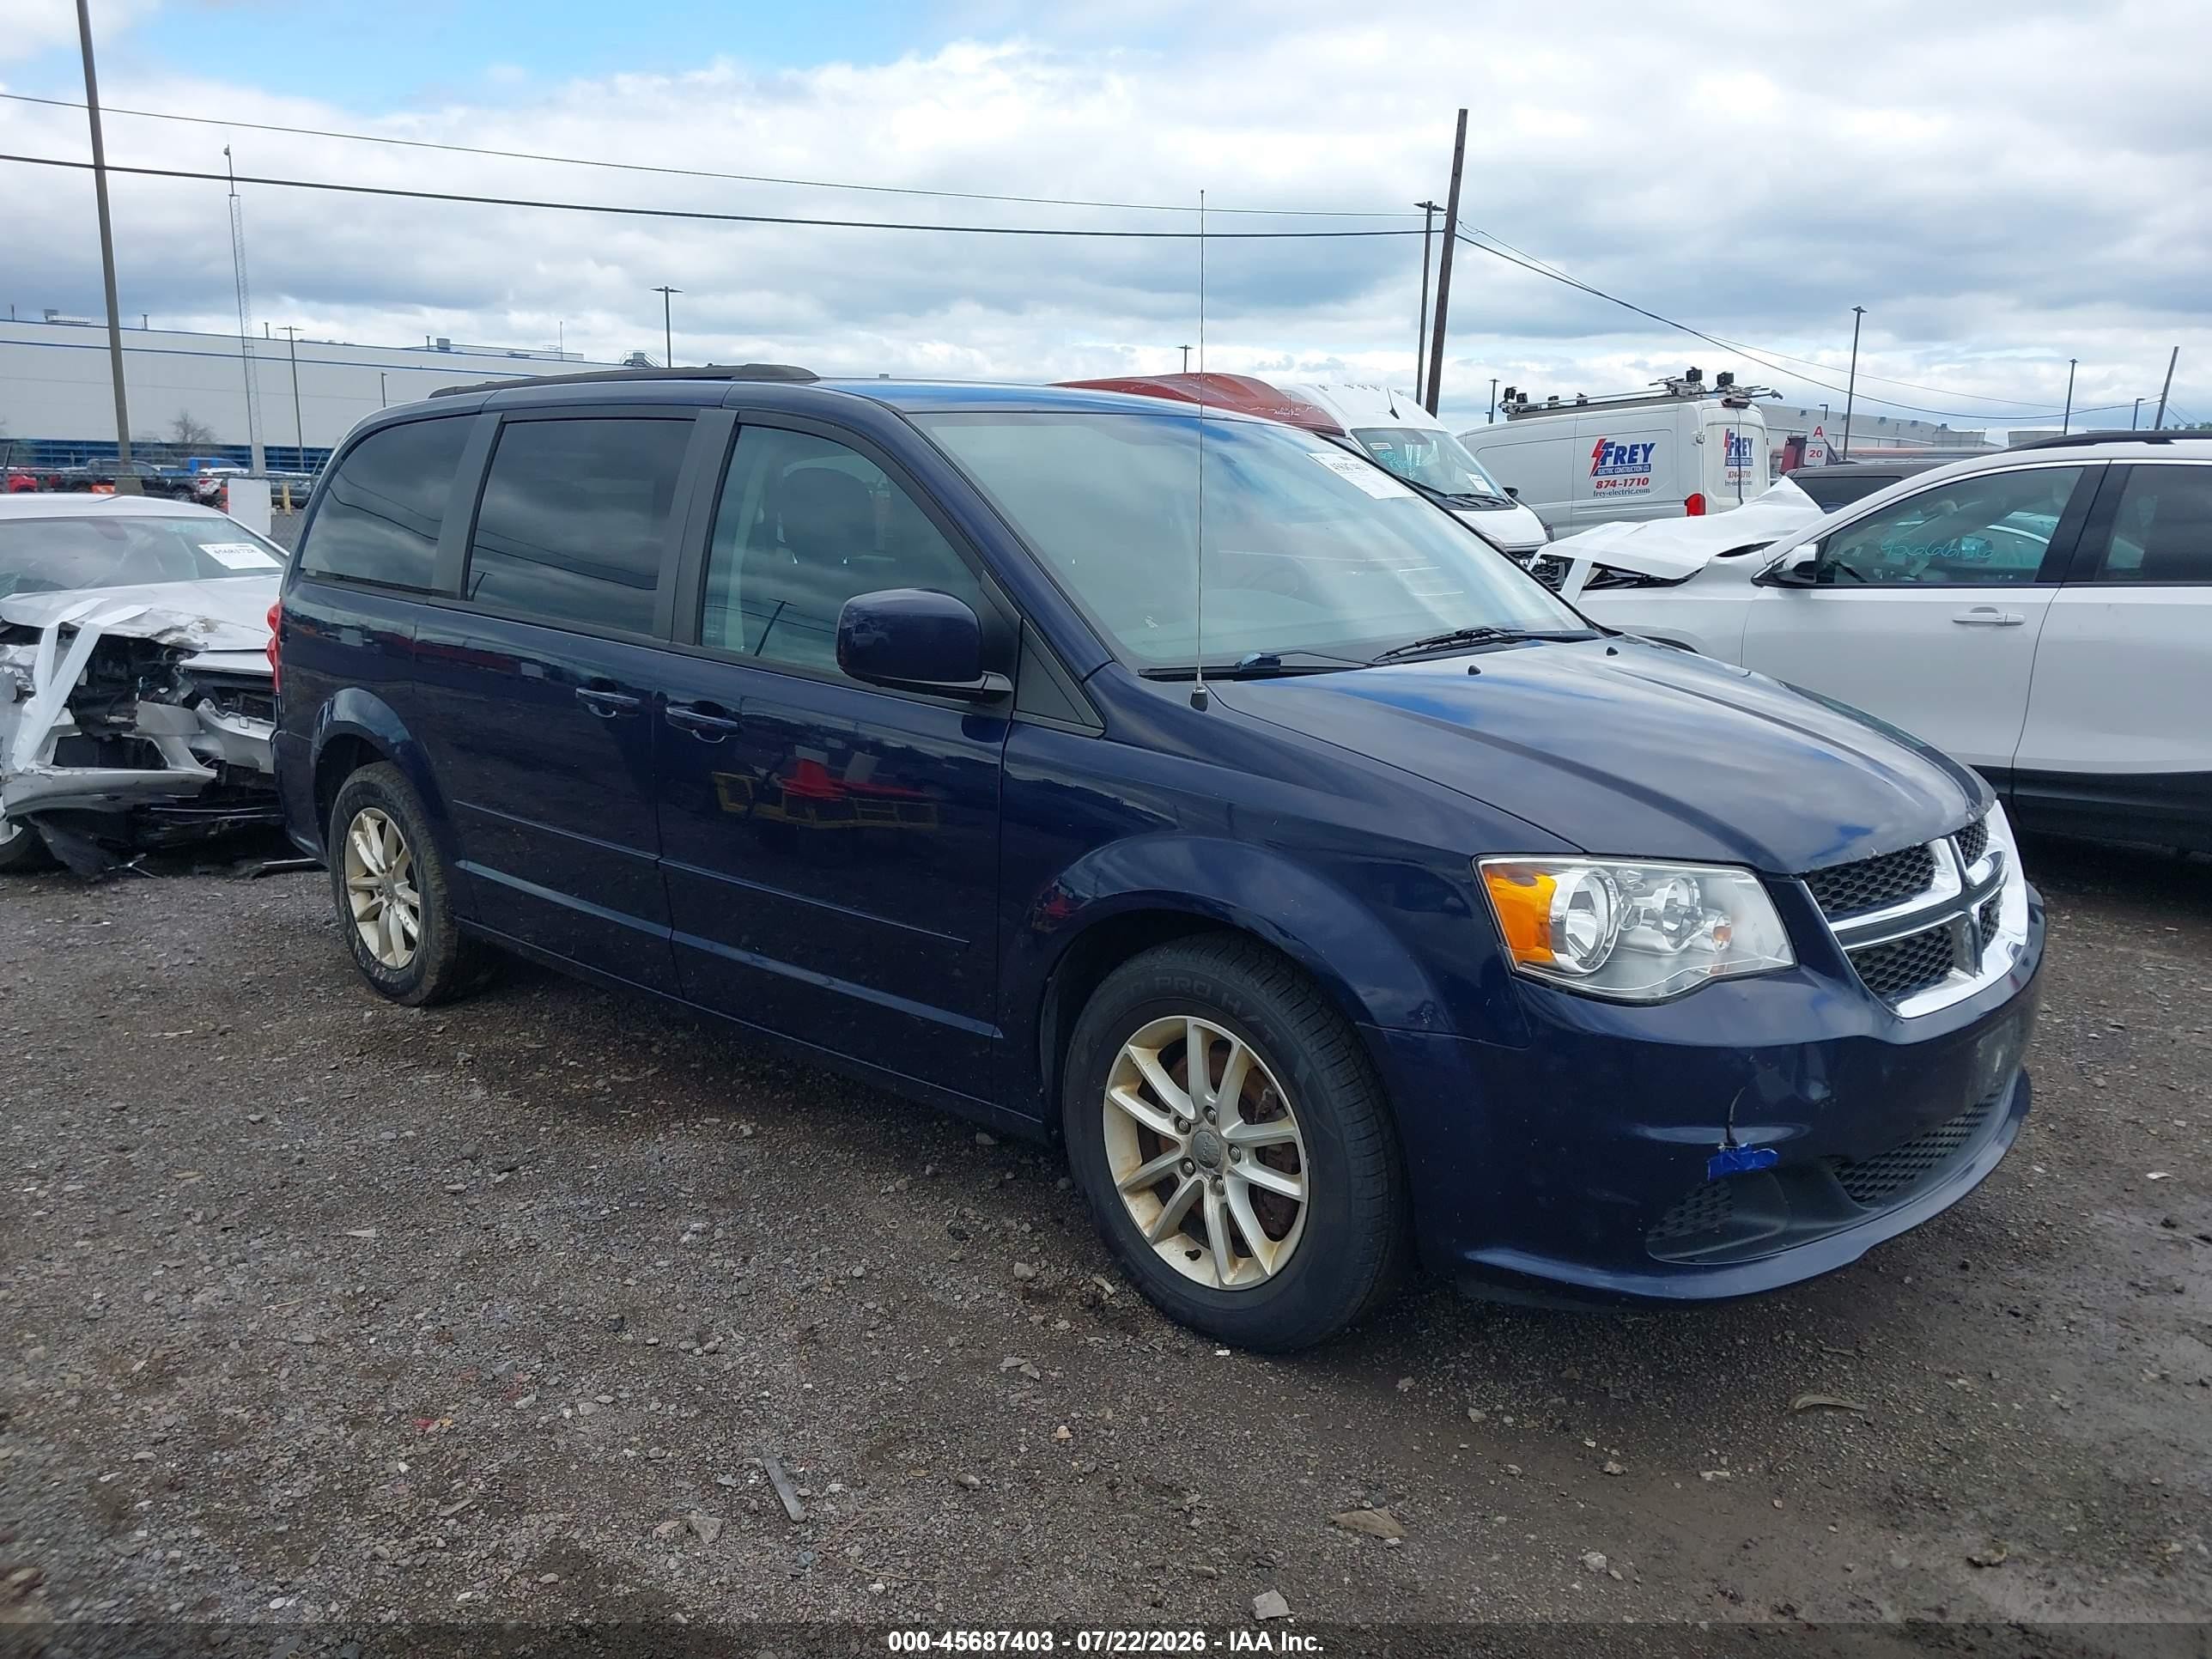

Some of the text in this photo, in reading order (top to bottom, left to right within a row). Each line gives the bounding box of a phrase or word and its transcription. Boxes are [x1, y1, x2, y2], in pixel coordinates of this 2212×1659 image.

[1813, 426, 1824, 438] A
[1728, 433, 1753, 457] FREY
[1599, 441, 1656, 465] FREY
[1808, 449, 1823, 459] 20
[1595, 477, 1650, 489] 874-1710
[1593, 488, 1650, 497] frey-electric.com
